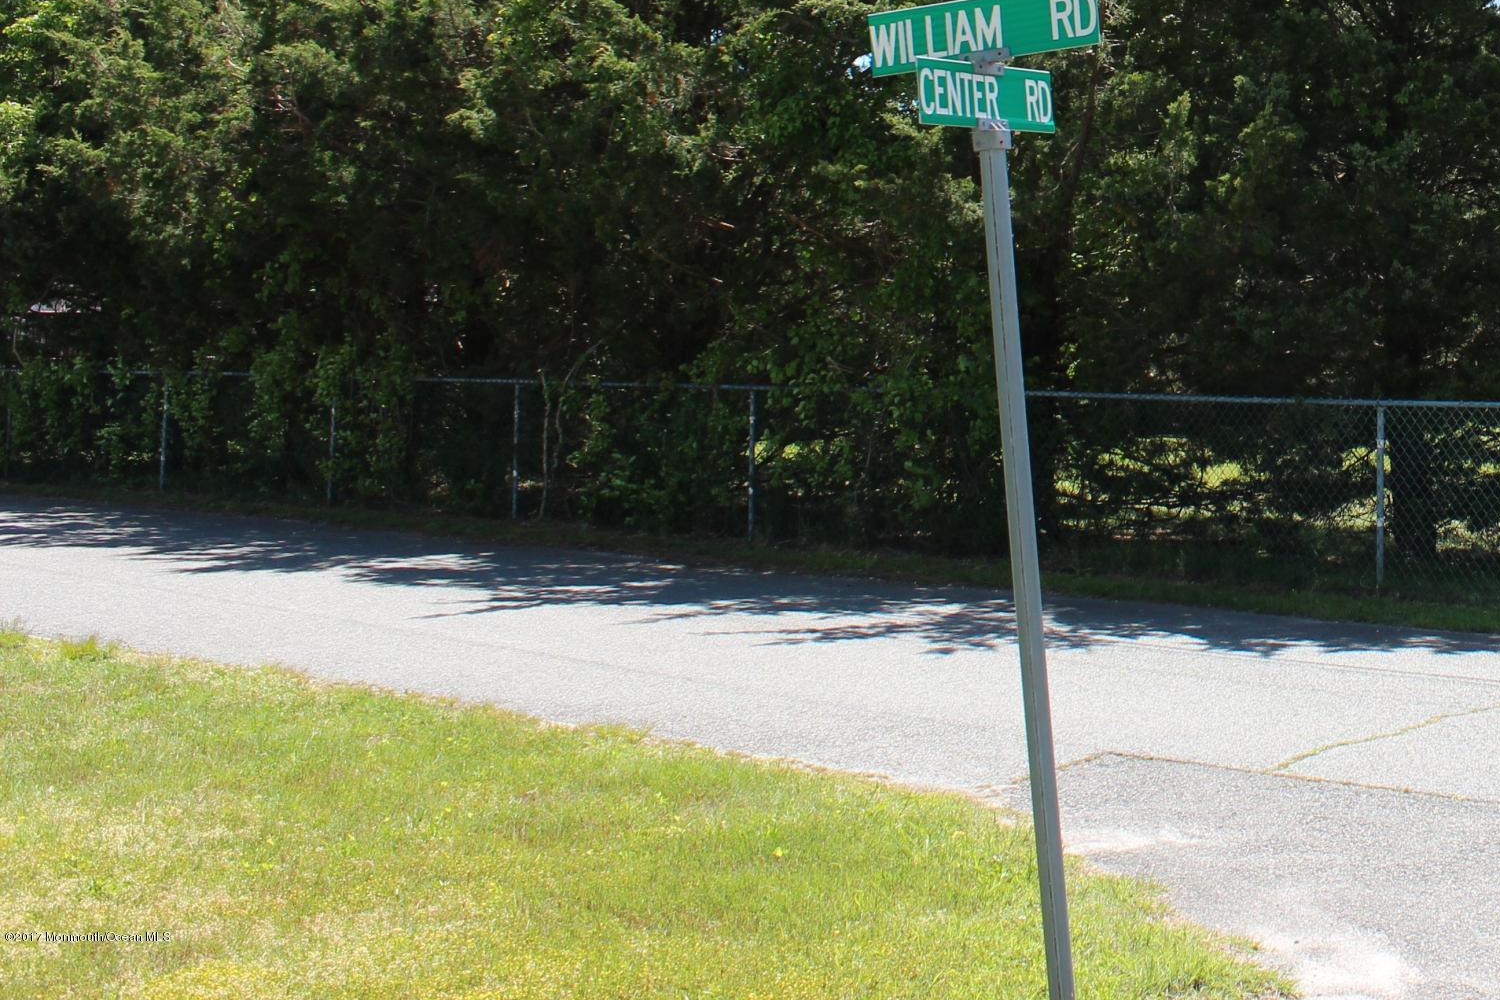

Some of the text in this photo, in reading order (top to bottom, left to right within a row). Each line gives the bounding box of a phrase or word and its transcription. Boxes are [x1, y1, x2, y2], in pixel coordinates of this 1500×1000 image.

[870, 5, 1003, 68] WILLIAM
[919, 67, 1051, 123] CENTER RD
